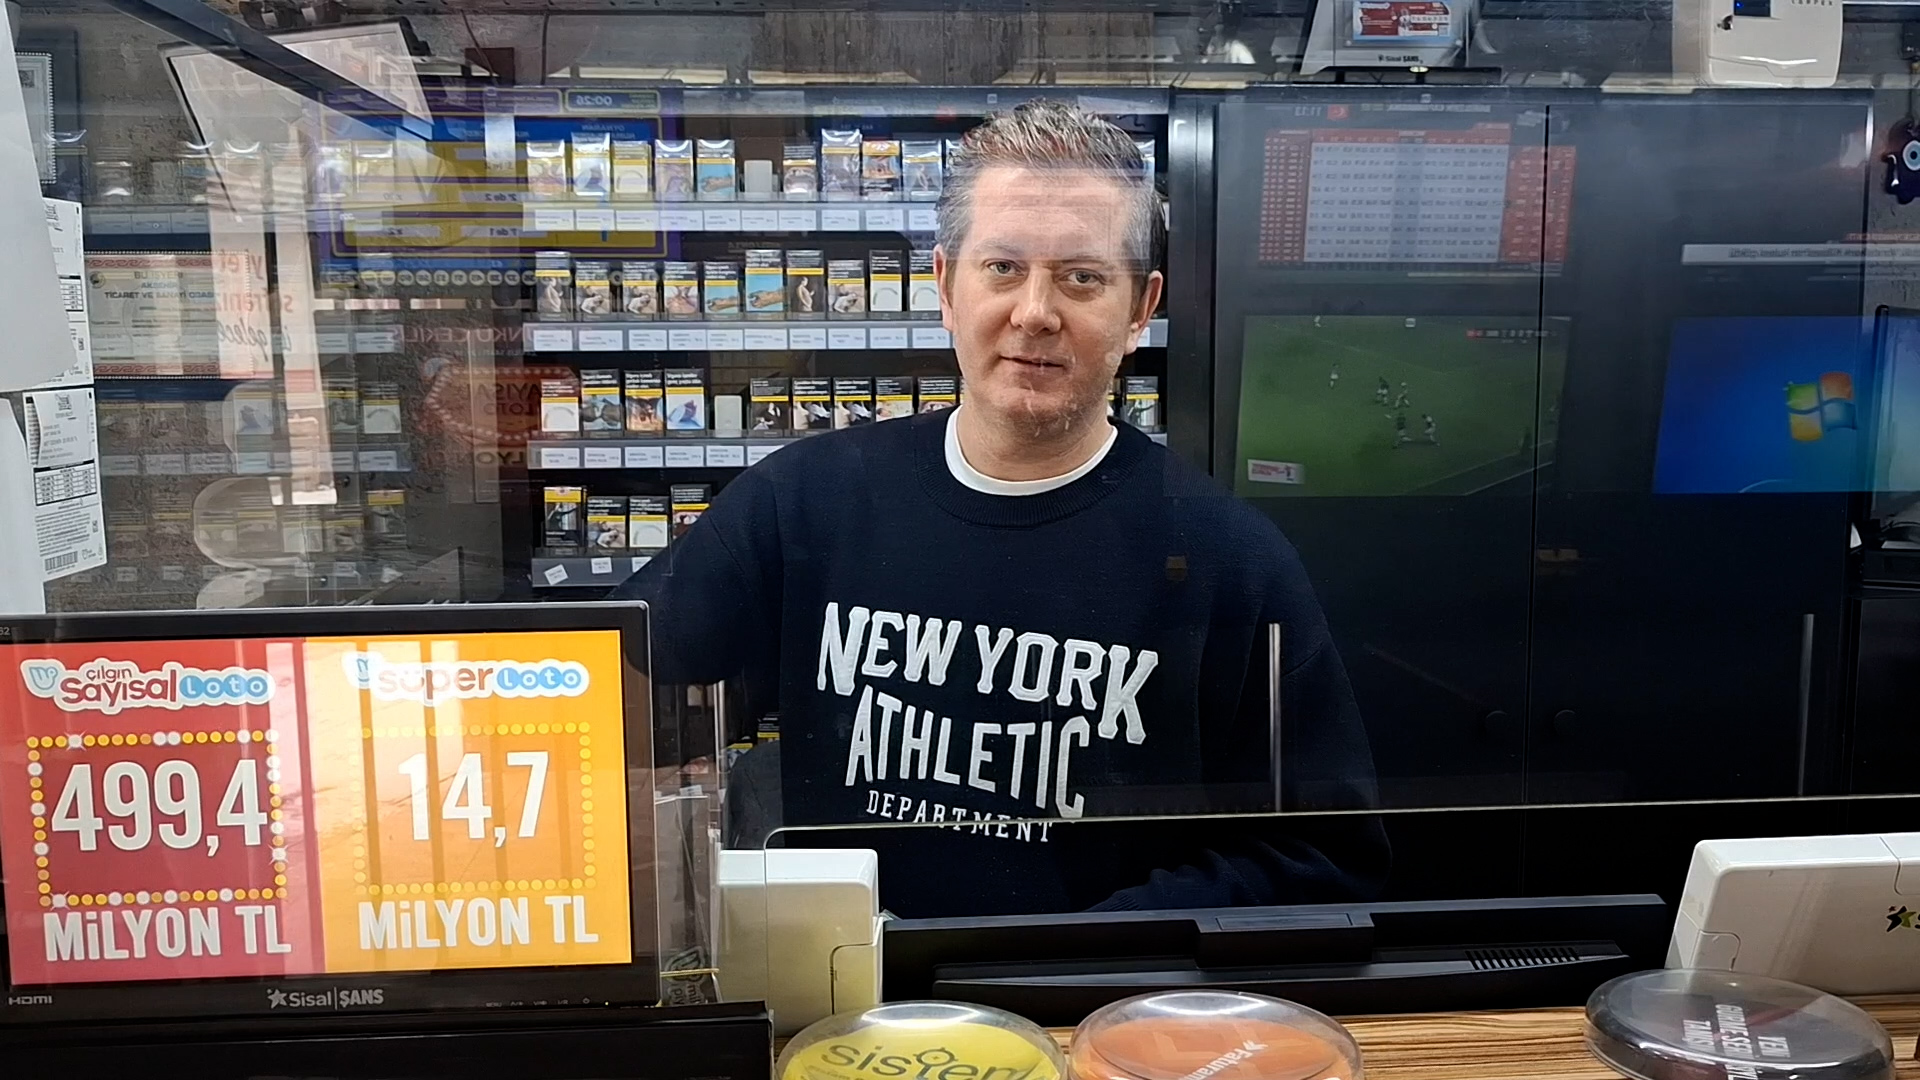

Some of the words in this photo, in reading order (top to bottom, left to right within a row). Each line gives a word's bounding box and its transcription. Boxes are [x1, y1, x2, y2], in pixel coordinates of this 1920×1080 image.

[817, 602, 962, 696] NEW
[974, 625, 1158, 745] YORK
[845, 684, 1090, 819] ATHLETIC
[51, 759, 268, 857] 499,4
[398, 751, 549, 848] 14,7
[866, 790, 1053, 843] DEPARTMENT
[234, 905, 292, 955] TL
[544, 895, 599, 944] TL
[8, 995, 52, 1005] HDMI
[289, 991, 332, 1007] Sisal
